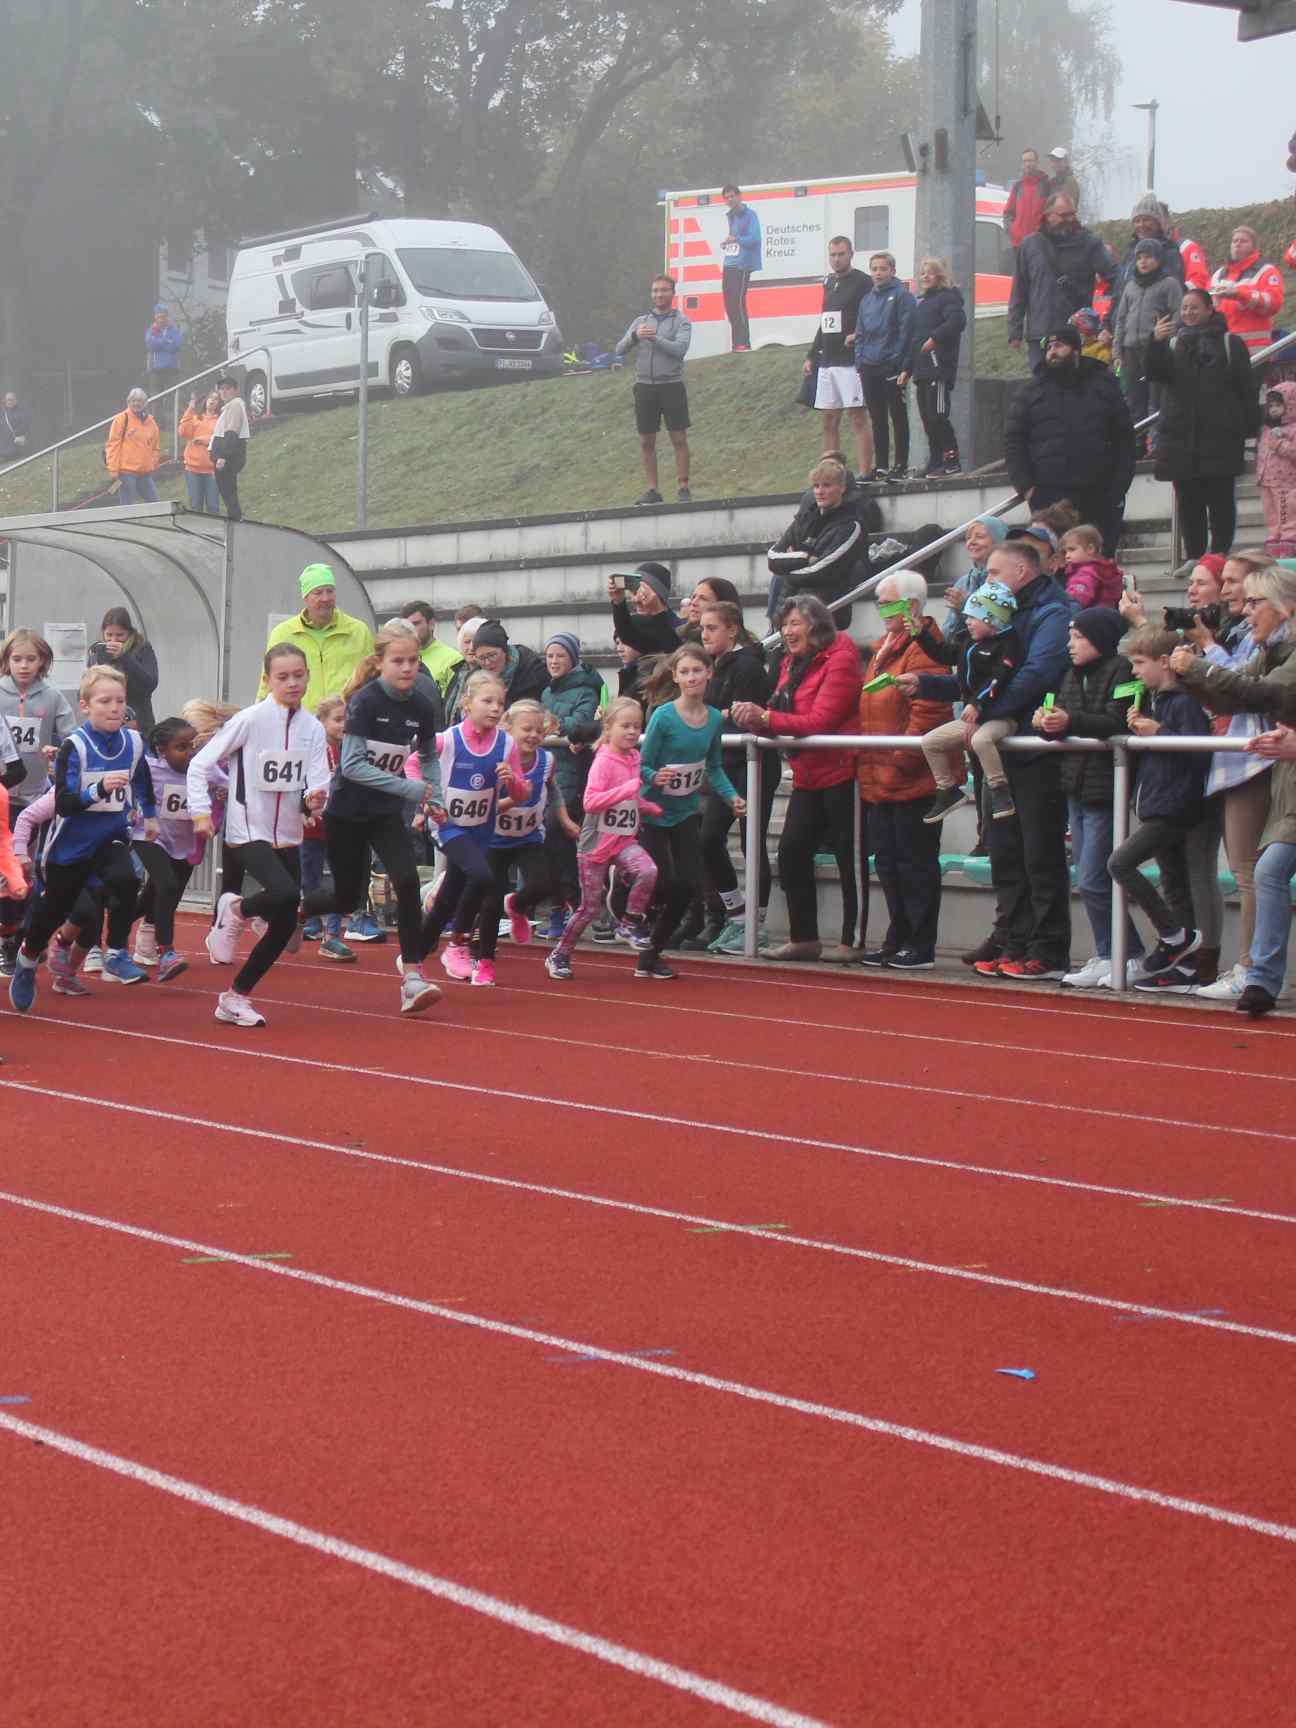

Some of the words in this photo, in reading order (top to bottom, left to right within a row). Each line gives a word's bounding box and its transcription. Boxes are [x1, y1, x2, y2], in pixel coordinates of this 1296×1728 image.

[766, 223, 821, 235] Deutsches
[766, 237, 796, 247] Rotes
[766, 247, 796, 257] Kreuz
[10, 726, 36, 745] 34
[263, 760, 303, 783] 641
[670, 768, 704, 789] 612
[449, 798, 489, 818] 646
[498, 811, 537, 831] 614
[604, 808, 636, 829] 629
